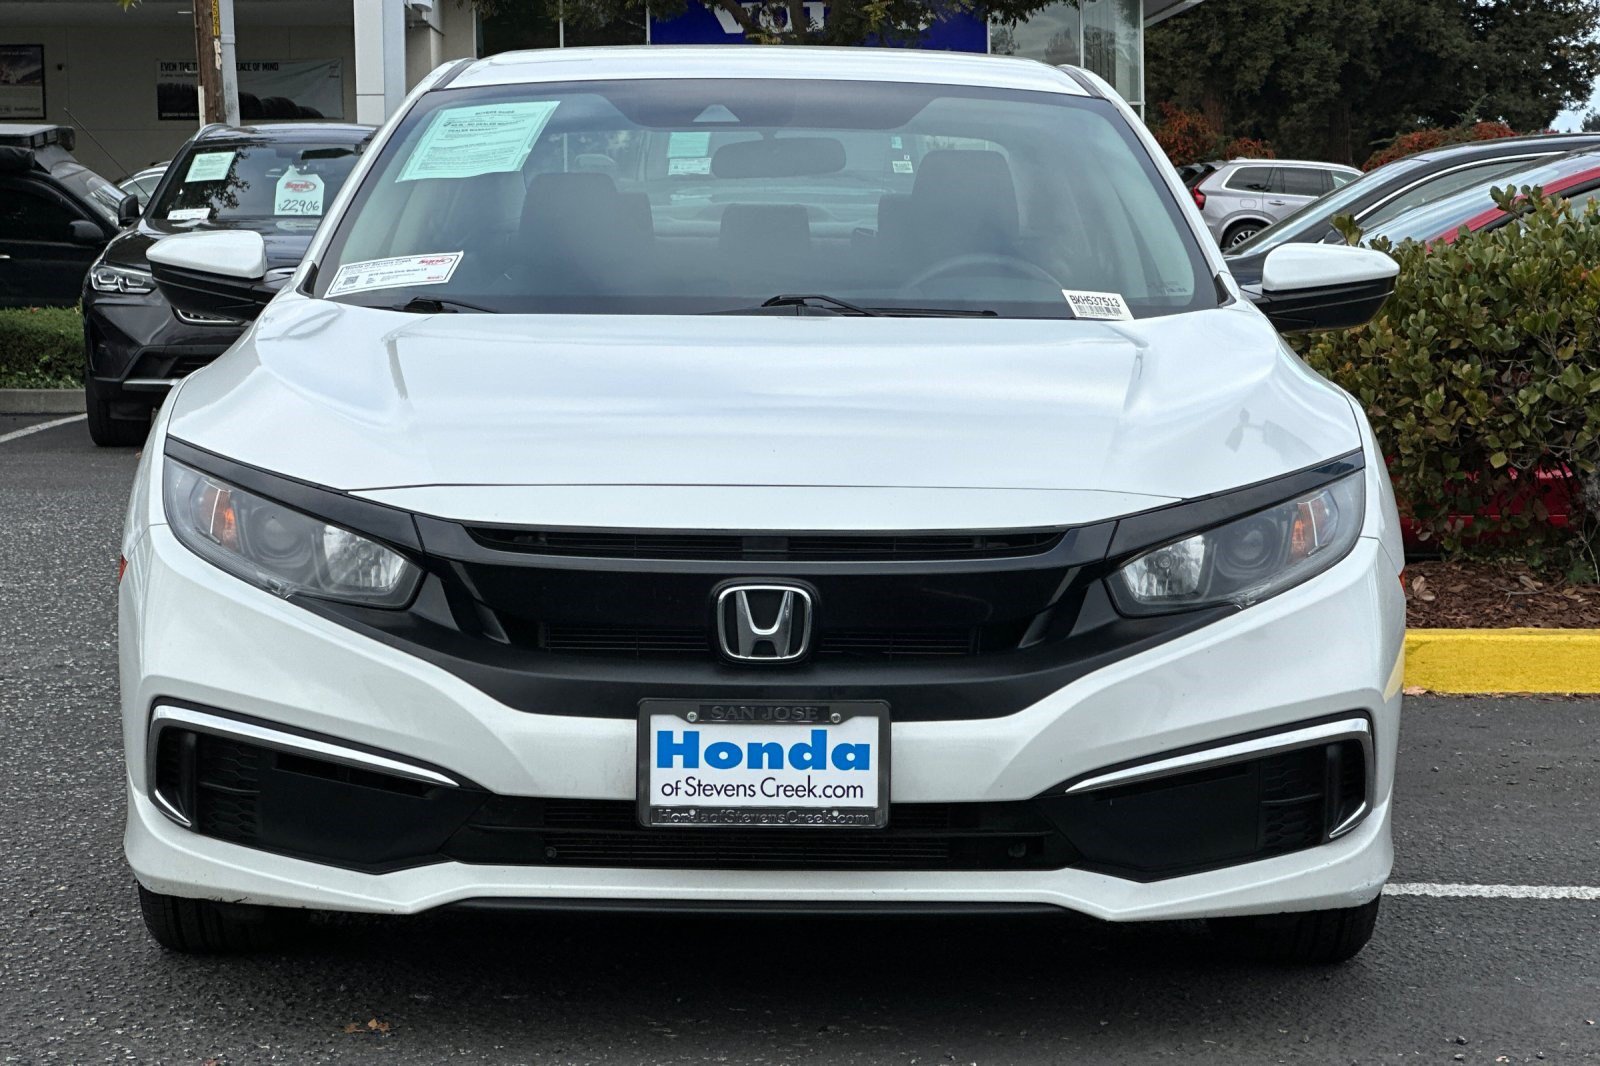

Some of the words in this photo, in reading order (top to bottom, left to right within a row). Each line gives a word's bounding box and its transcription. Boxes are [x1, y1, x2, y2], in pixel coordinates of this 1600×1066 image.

[161, 62, 177, 72] EVEN
[180, 62, 191, 72] THE
[236, 62, 252, 72] EACE
[252, 62, 260, 72] OF
[262, 62, 279, 72] MIND
[1069, 294, 1121, 308] BKH537513
[710, 705, 755, 720] SAN
[761, 706, 819, 721] JOSE
[656, 729, 871, 771] Honda
[661, 780, 682, 797] of
[684, 776, 757, 798] Stevens
[760, 775, 864, 799] Creek.com
